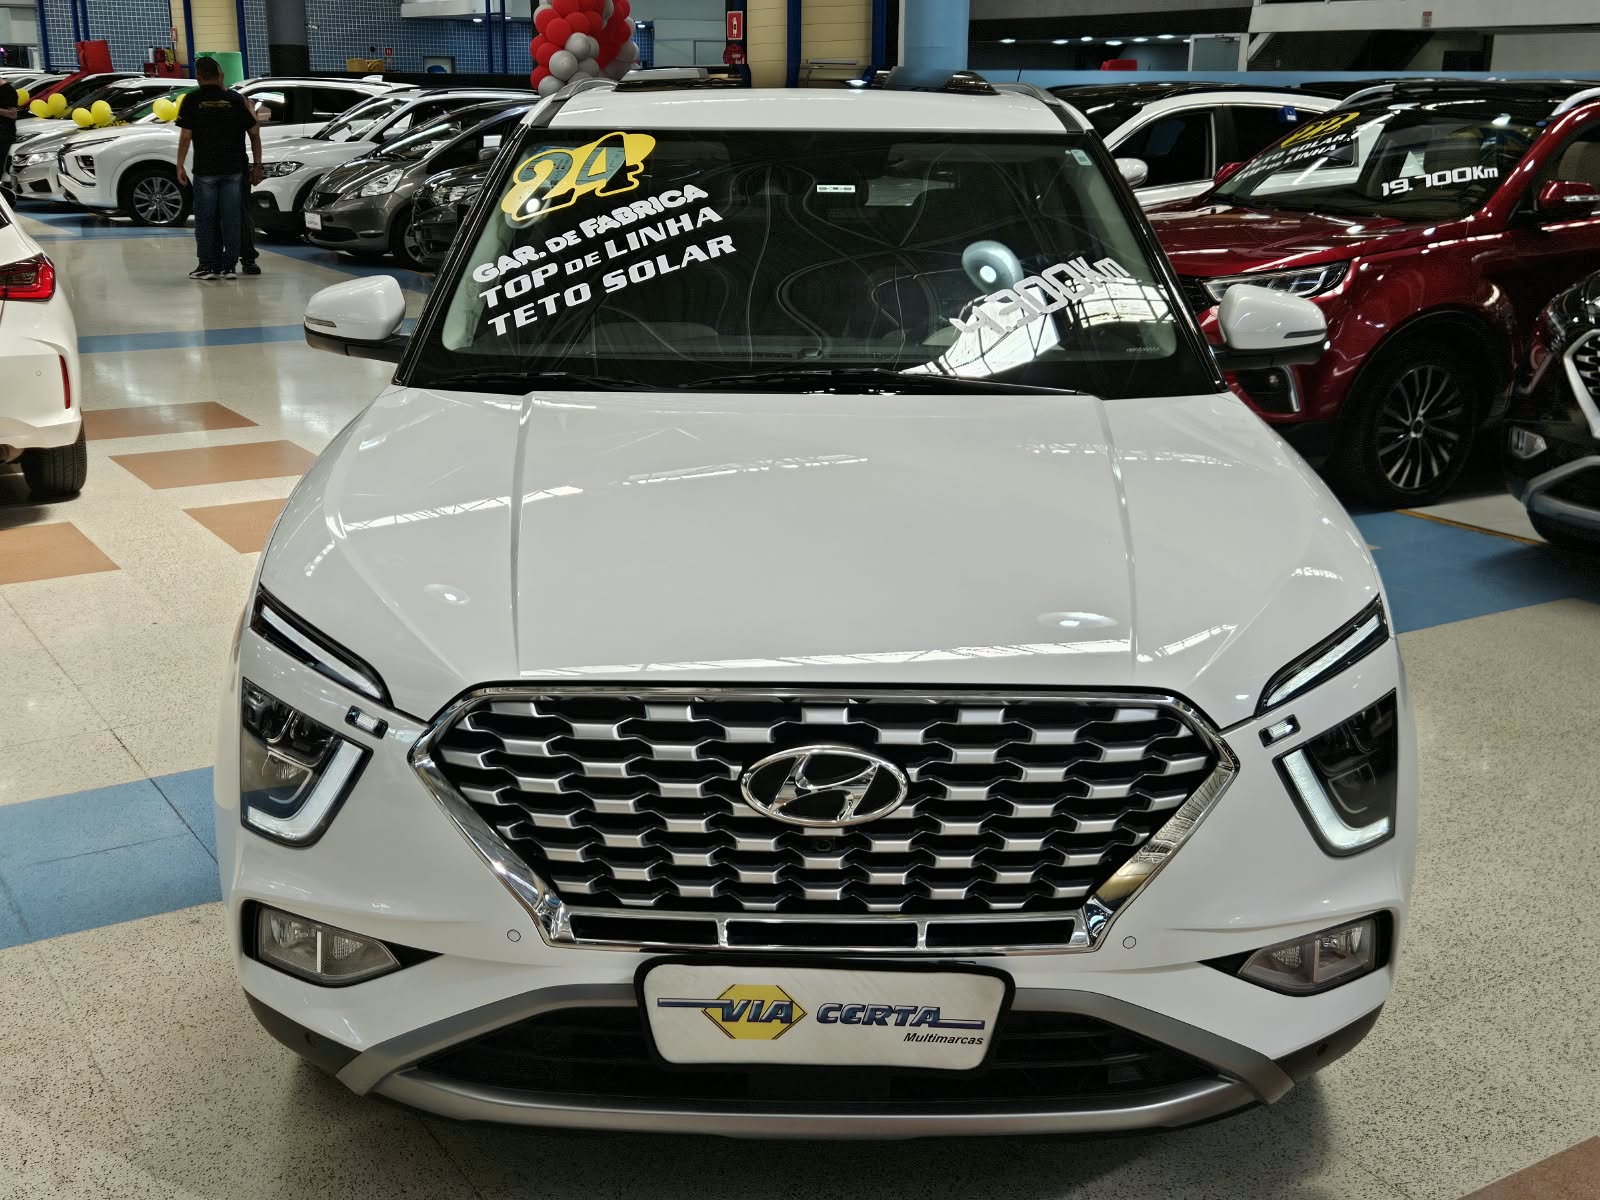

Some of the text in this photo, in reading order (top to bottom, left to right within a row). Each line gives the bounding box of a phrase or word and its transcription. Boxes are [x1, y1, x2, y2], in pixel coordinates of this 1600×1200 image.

[501, 131, 656, 221] 24
[472, 184, 709, 283] GAR. DE FABRICA
[479, 206, 724, 309] TOP DE LINHA
[487, 234, 737, 337] TETO SOLAR
[720, 999, 941, 1028] VIA CERTA
[903, 1032, 984, 1045] Multimarcas
